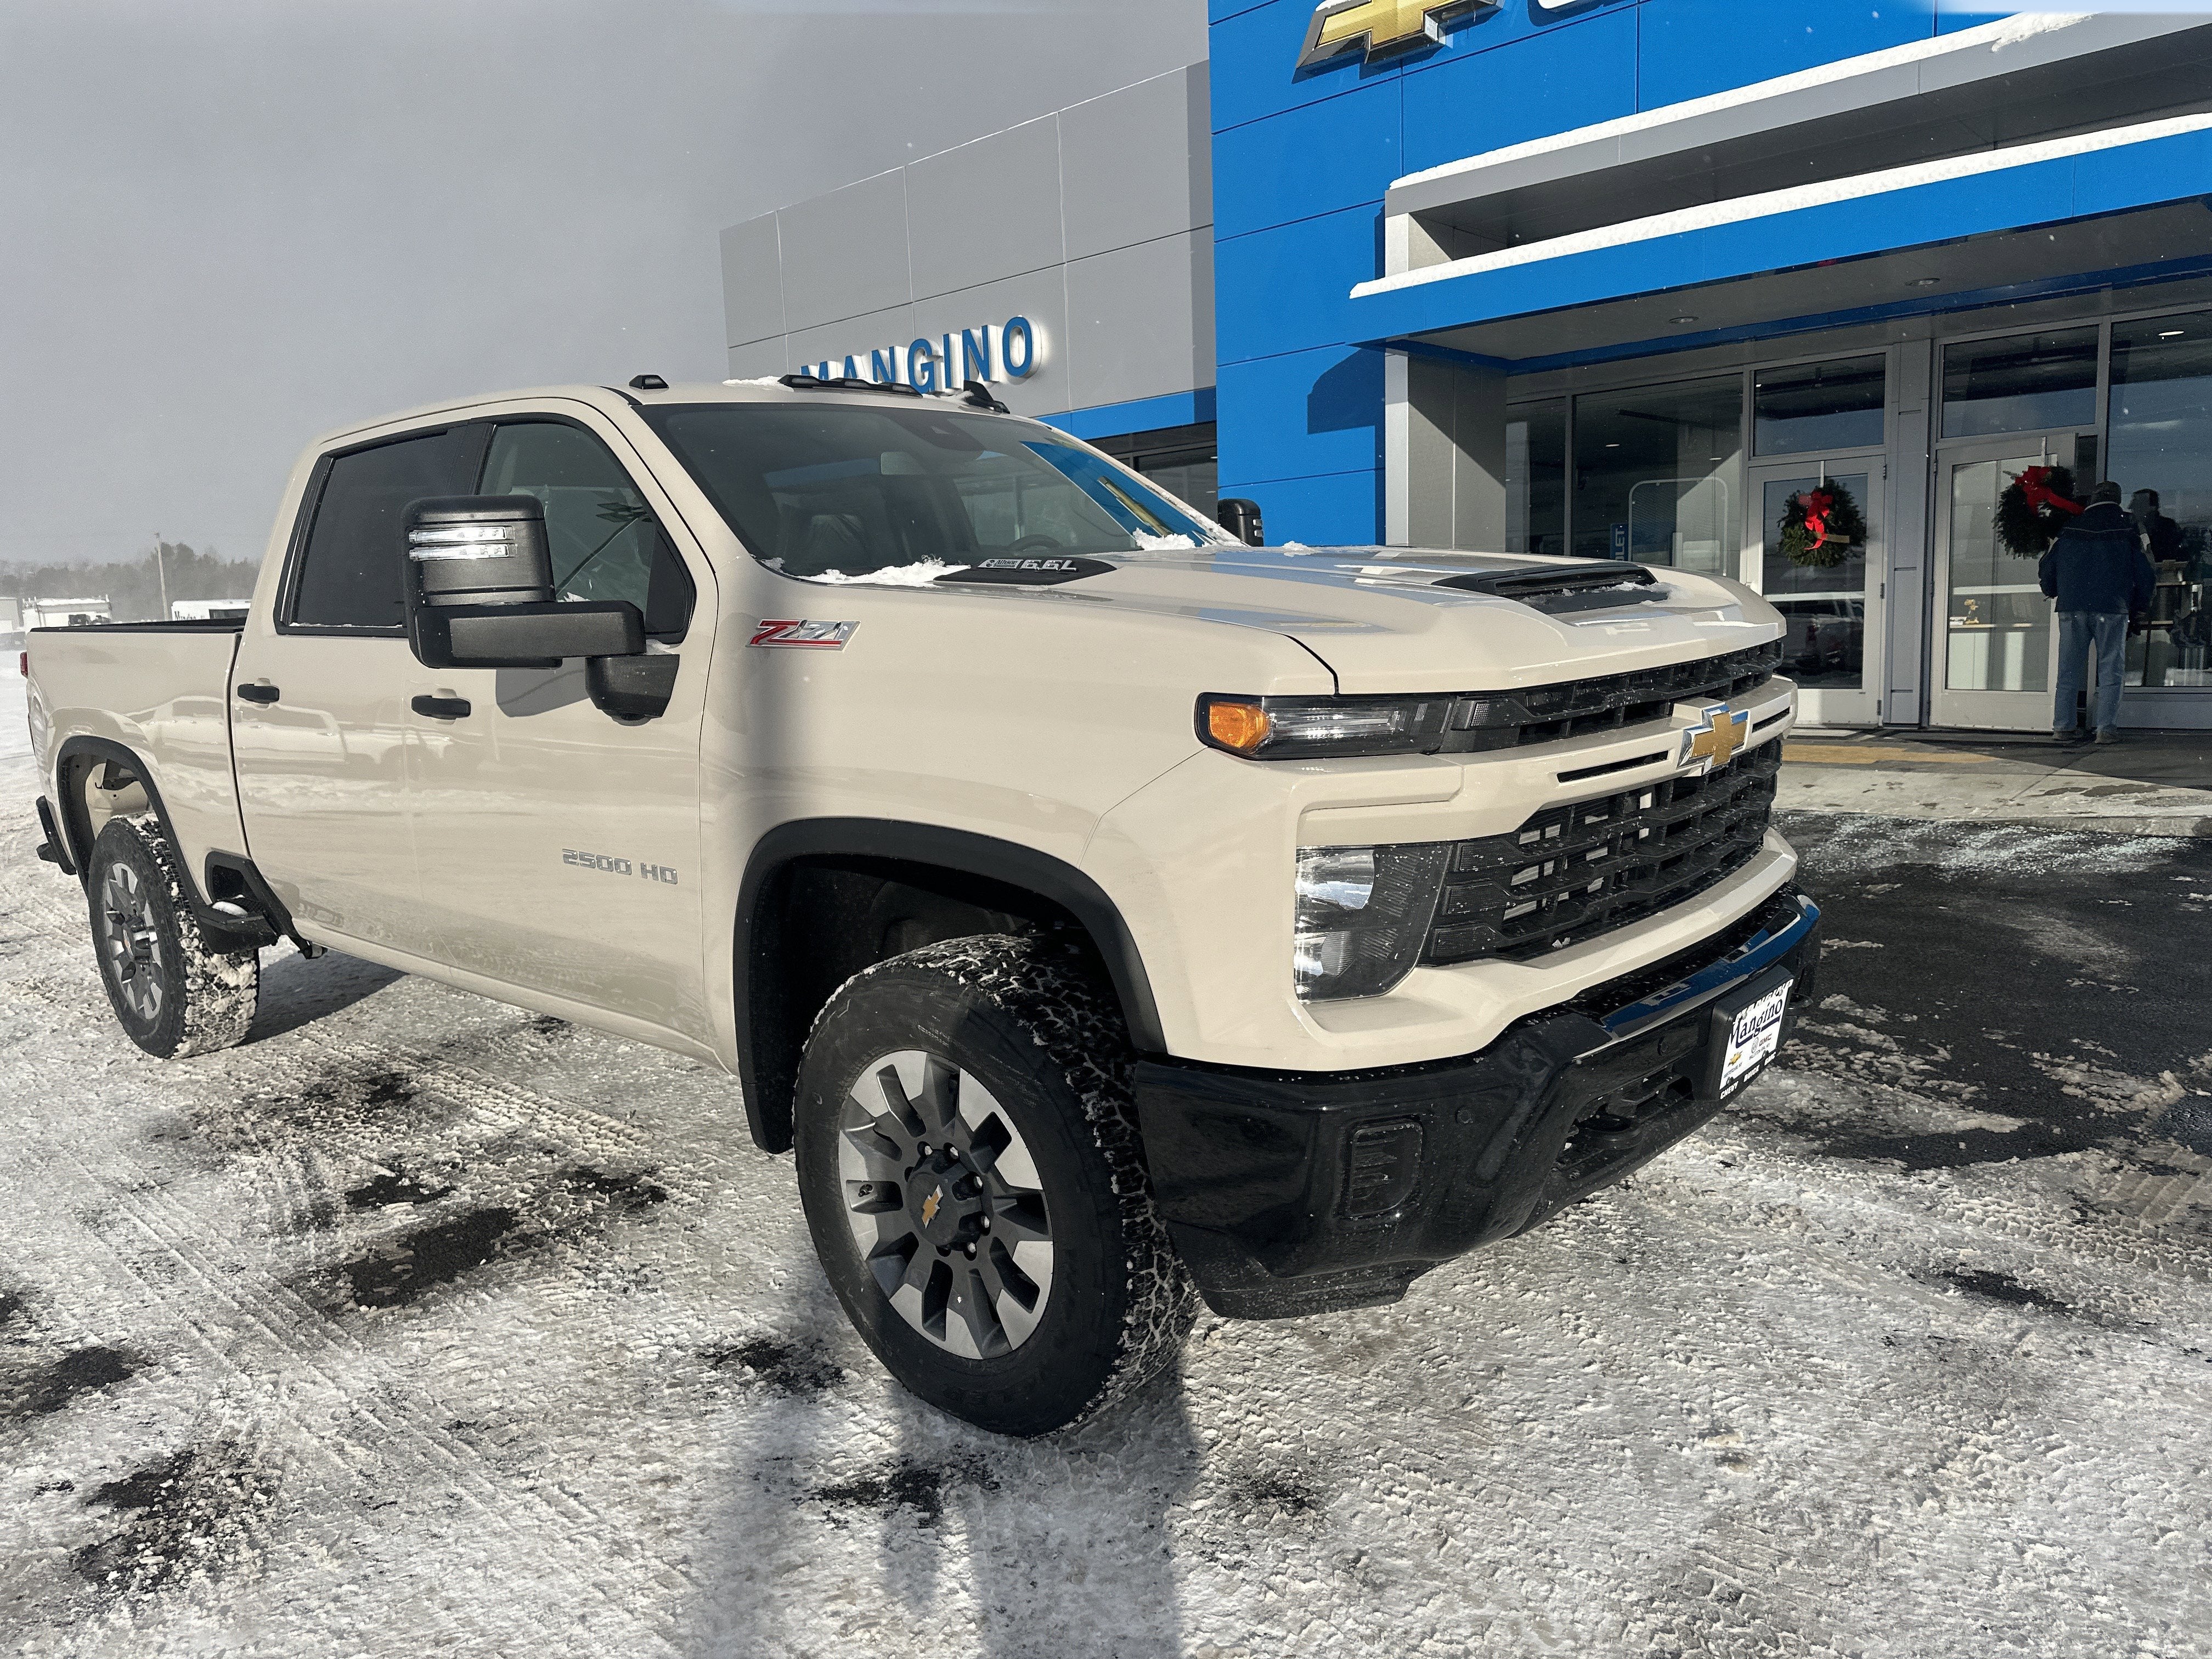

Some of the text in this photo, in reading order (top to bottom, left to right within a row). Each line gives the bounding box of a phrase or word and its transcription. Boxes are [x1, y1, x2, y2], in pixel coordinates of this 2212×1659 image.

[1615, 528, 1625, 561] LET
[746, 619, 861, 651] Z71
[562, 848, 678, 885] 2500 HD
[1720, 1081, 1739, 1099] CHEVY
